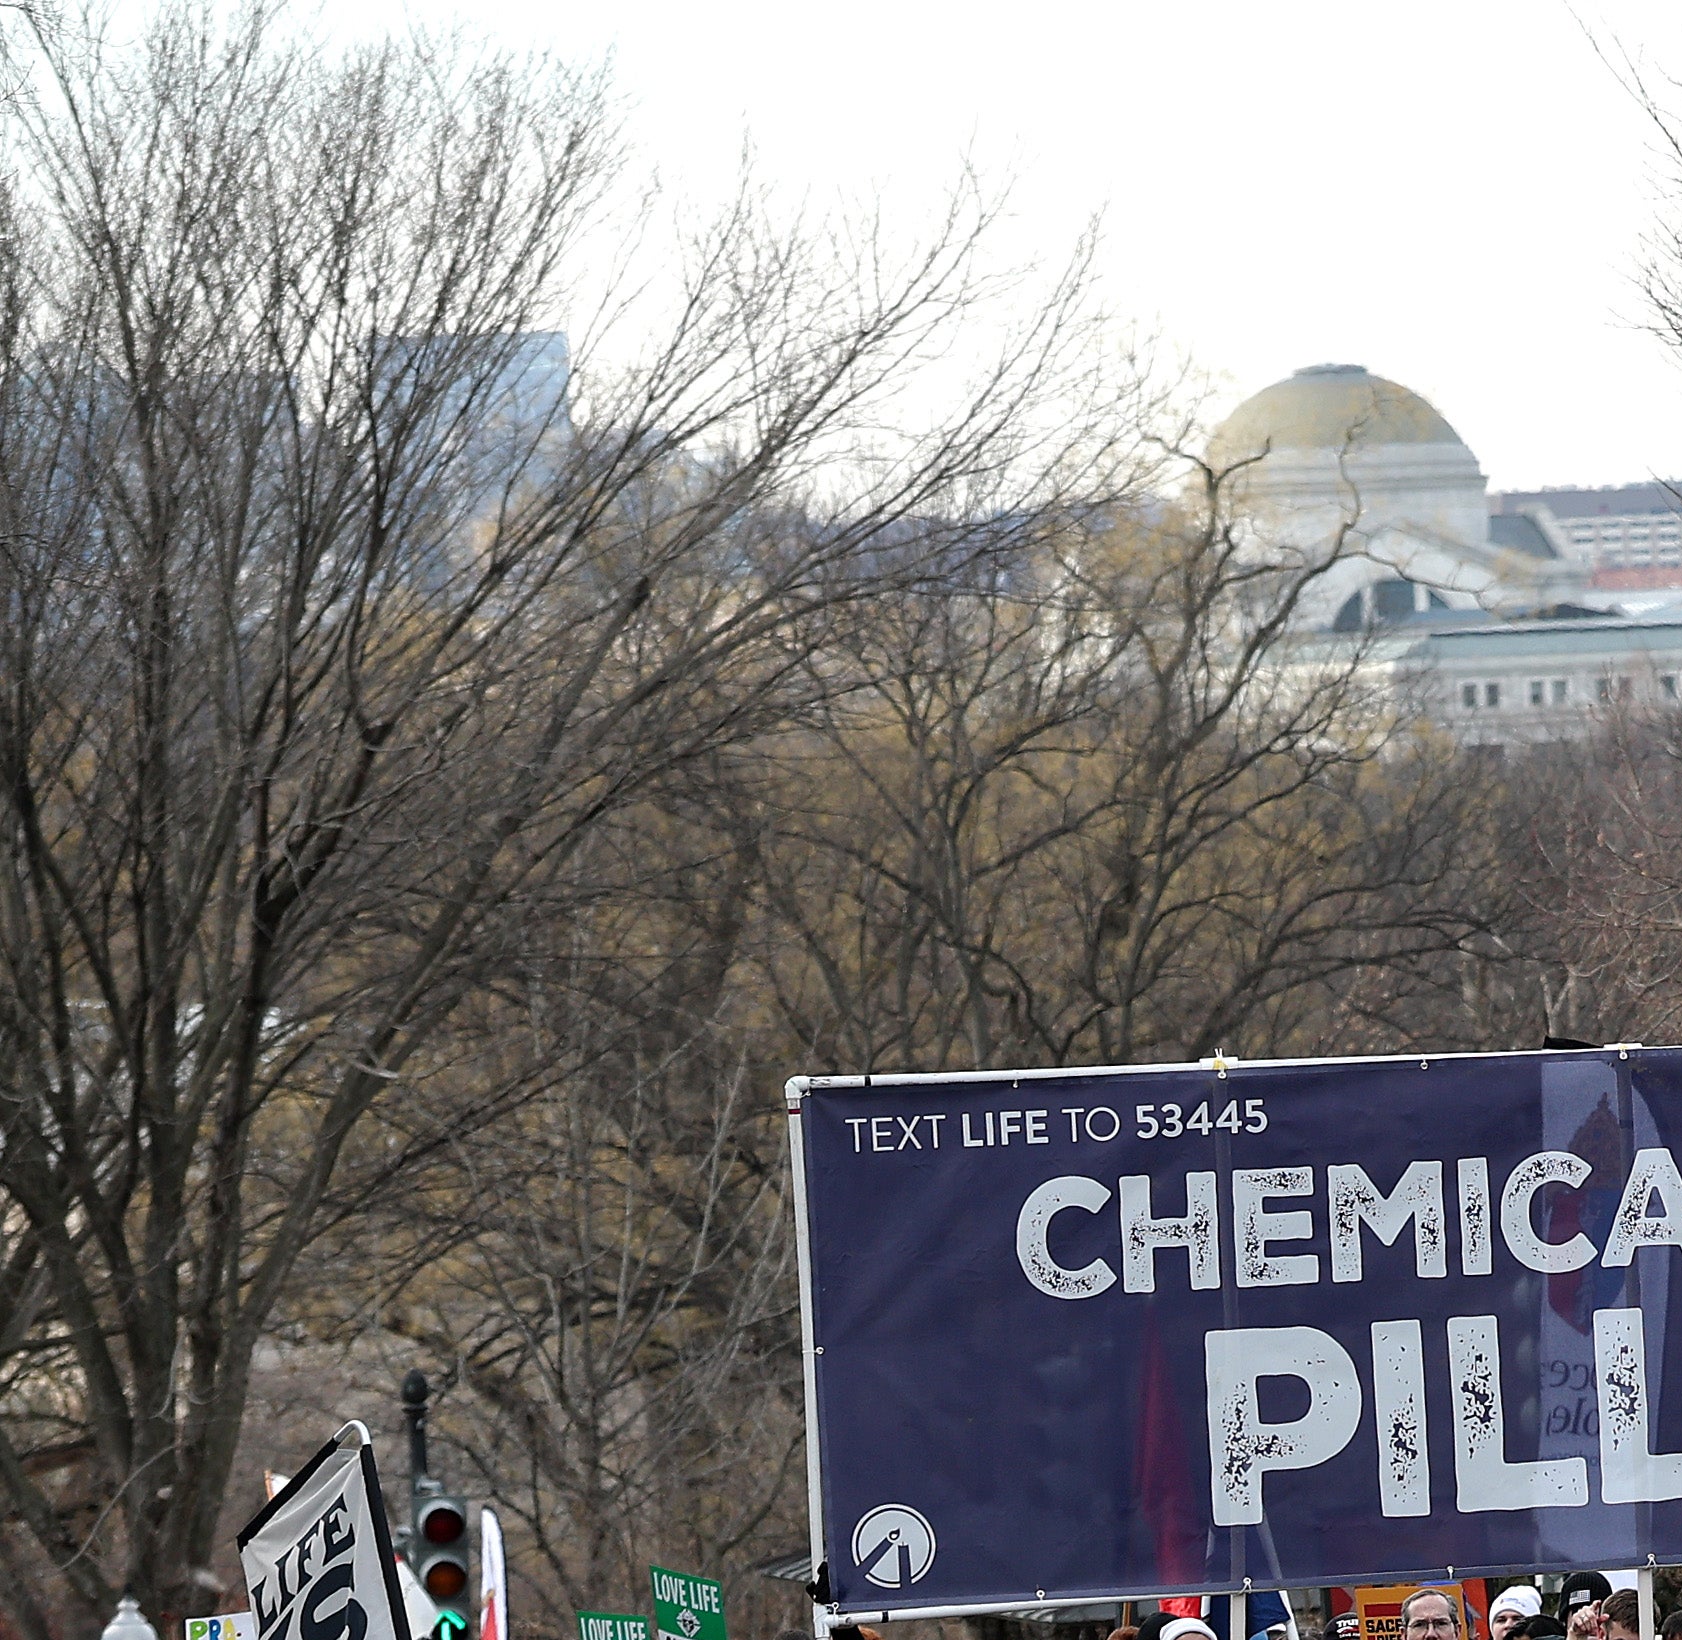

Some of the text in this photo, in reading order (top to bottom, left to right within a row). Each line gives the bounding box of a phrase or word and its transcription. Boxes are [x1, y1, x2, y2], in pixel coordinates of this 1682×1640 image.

[845, 1098, 1268, 1153] TEXT LIFE TO 53445
[251, 1494, 356, 1640] LIFE
[653, 1571, 720, 1614] LOVE LIFE
